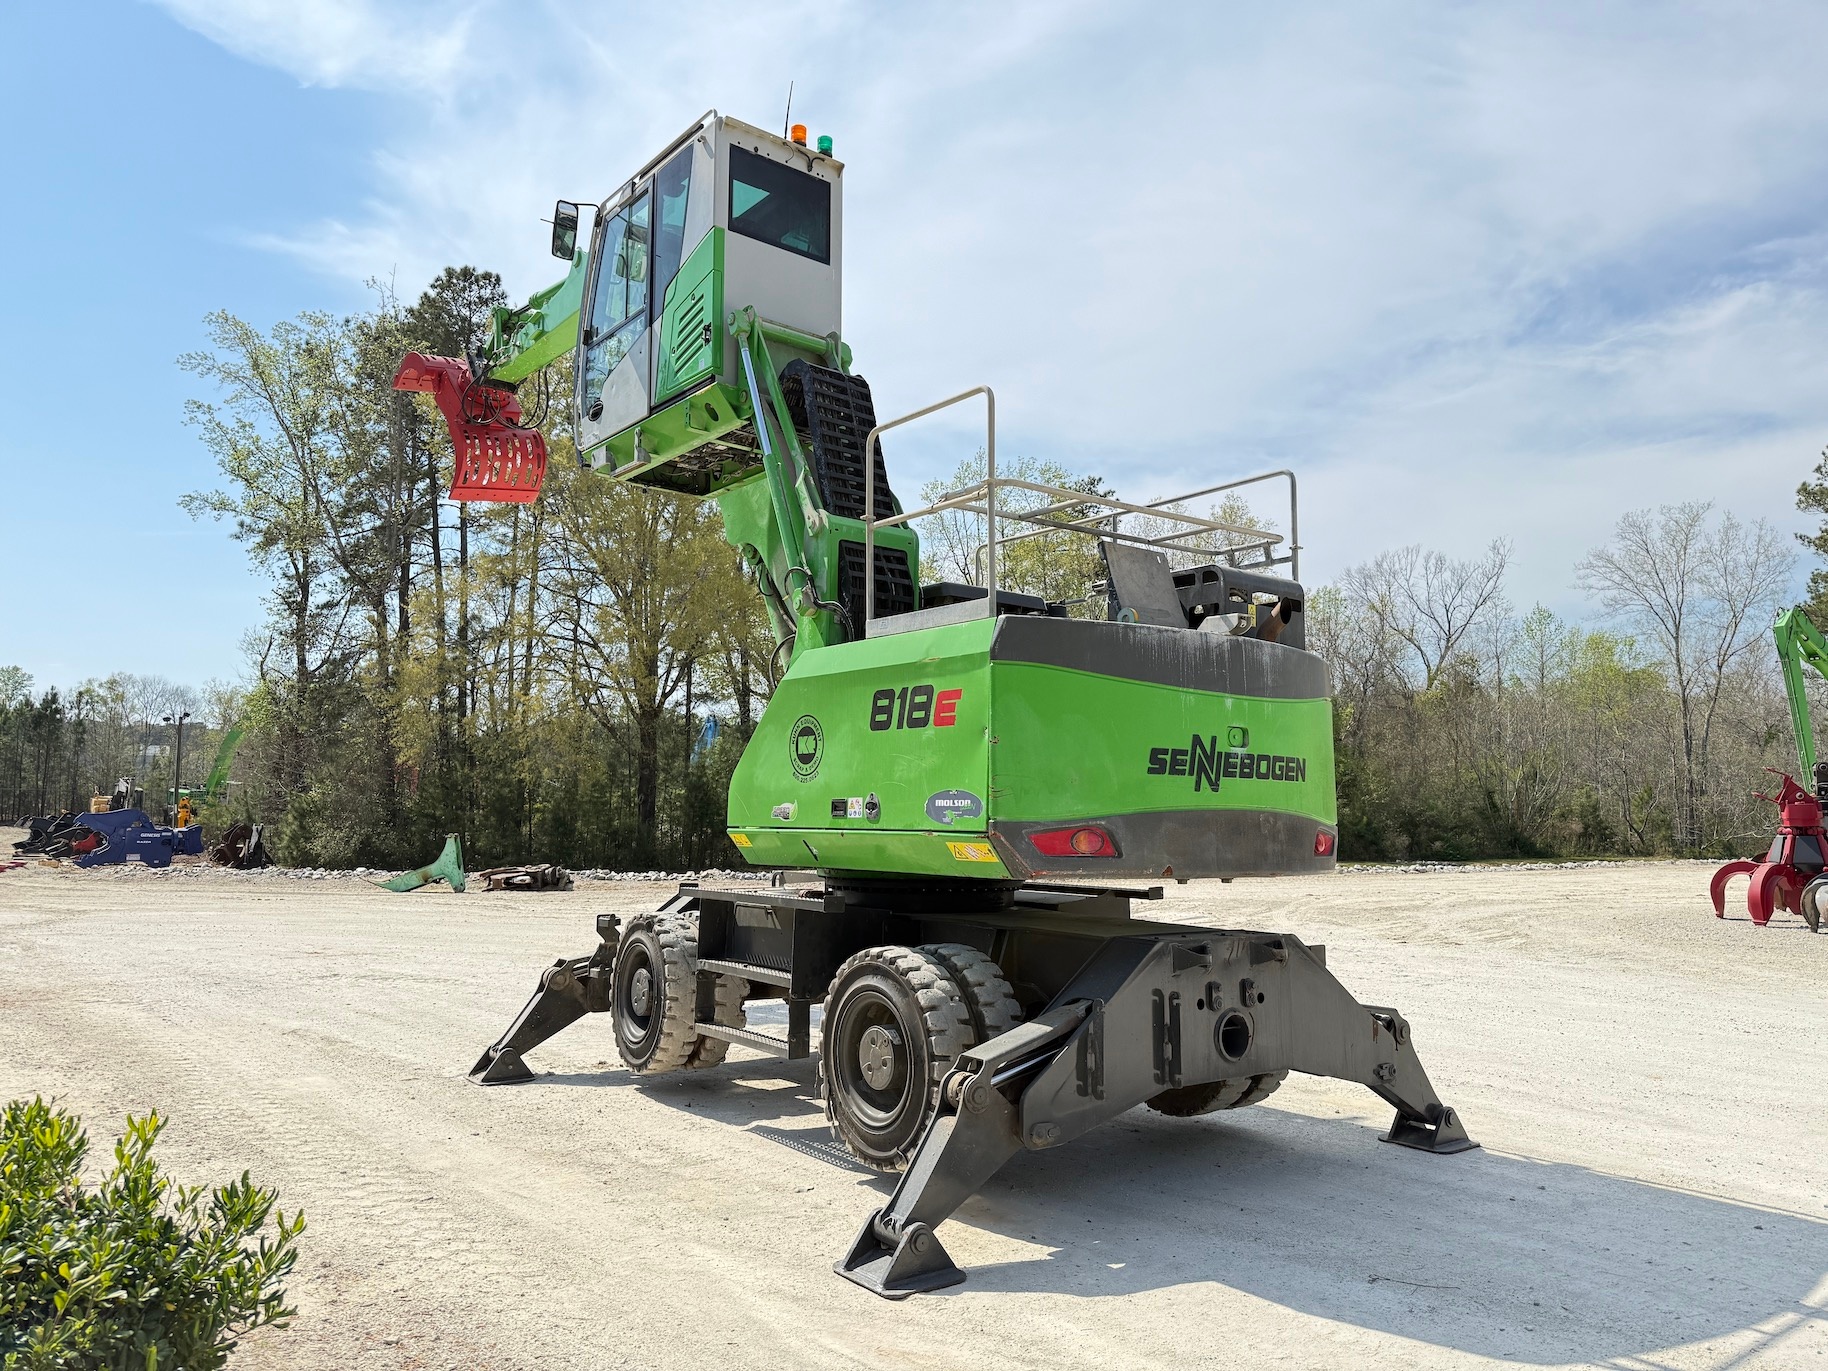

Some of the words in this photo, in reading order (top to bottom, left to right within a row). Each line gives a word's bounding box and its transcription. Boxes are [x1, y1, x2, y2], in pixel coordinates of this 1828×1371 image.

[870, 684, 962, 731] 818E
[791, 723, 801, 745] KUHN
[800, 718, 821, 741] EQUIPMENT
[1147, 733, 1307, 793] SENNEBOGEN
[935, 799, 971, 807] MOLSON
